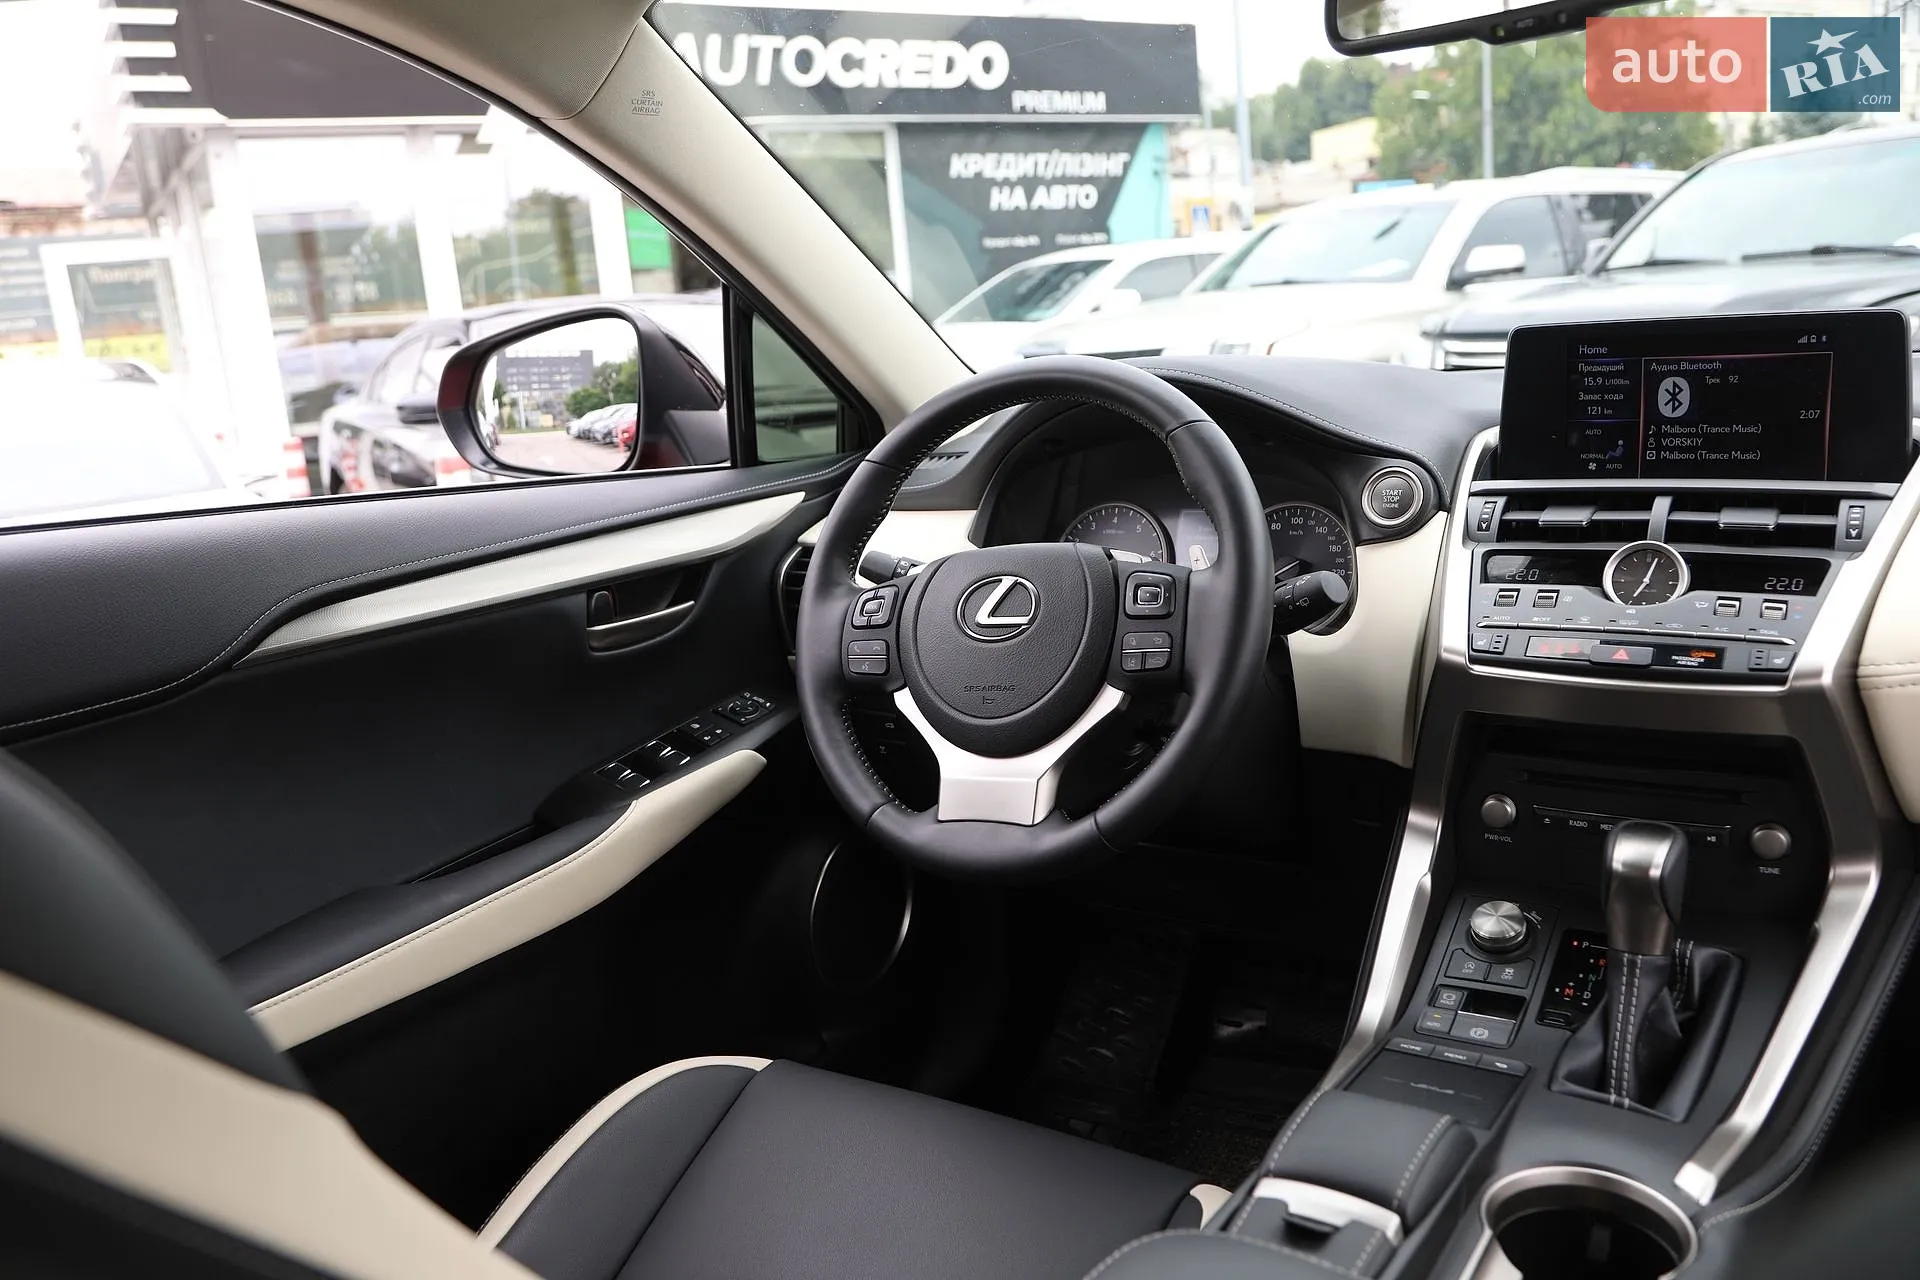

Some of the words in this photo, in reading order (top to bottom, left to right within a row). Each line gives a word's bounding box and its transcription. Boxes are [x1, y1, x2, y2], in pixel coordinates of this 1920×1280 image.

[641, 89, 656, 97] SRS
[631, 99, 664, 107] CURTAIN
[1011, 90, 1106, 113] PREMIUM
[631, 106, 661, 114] AIRBAG
[989, 185, 1028, 211] НА
[1030, 184, 1098, 210] АВТО
[1579, 345, 1608, 354] Home
[1650, 362, 1678, 372] Аудио
[1680, 362, 1722, 370] Bluetooth
[1584, 377, 1603, 386] 15.9
[1705, 376, 1720, 384] Трек
[1728, 376, 1739, 384] 92
[1578, 392, 1602, 400] Запас
[1604, 393, 1624, 401] хода
[1588, 406, 1601, 415] 121
[1800, 410, 1821, 419] 2:07
[1661, 425, 1696, 434] Malboro
[1698, 424, 1730, 434] (Trance
[1732, 424, 1762, 434] Music)
[1661, 438, 1703, 447] VORSKIY
[1660, 450, 1696, 460] Malboro
[1697, 450, 1730, 460] (Trance
[1731, 450, 1761, 460] Music)
[1291, 517, 1303, 525] 100
[1505, 568, 1540, 580] 22.0
[1764, 577, 1804, 591] 22.0
[1569, 820, 1589, 828] RADIO
[1759, 866, 1781, 875] TUNE
[1582, 941, 1589, 949] P
[1564, 988, 1574, 996] M
